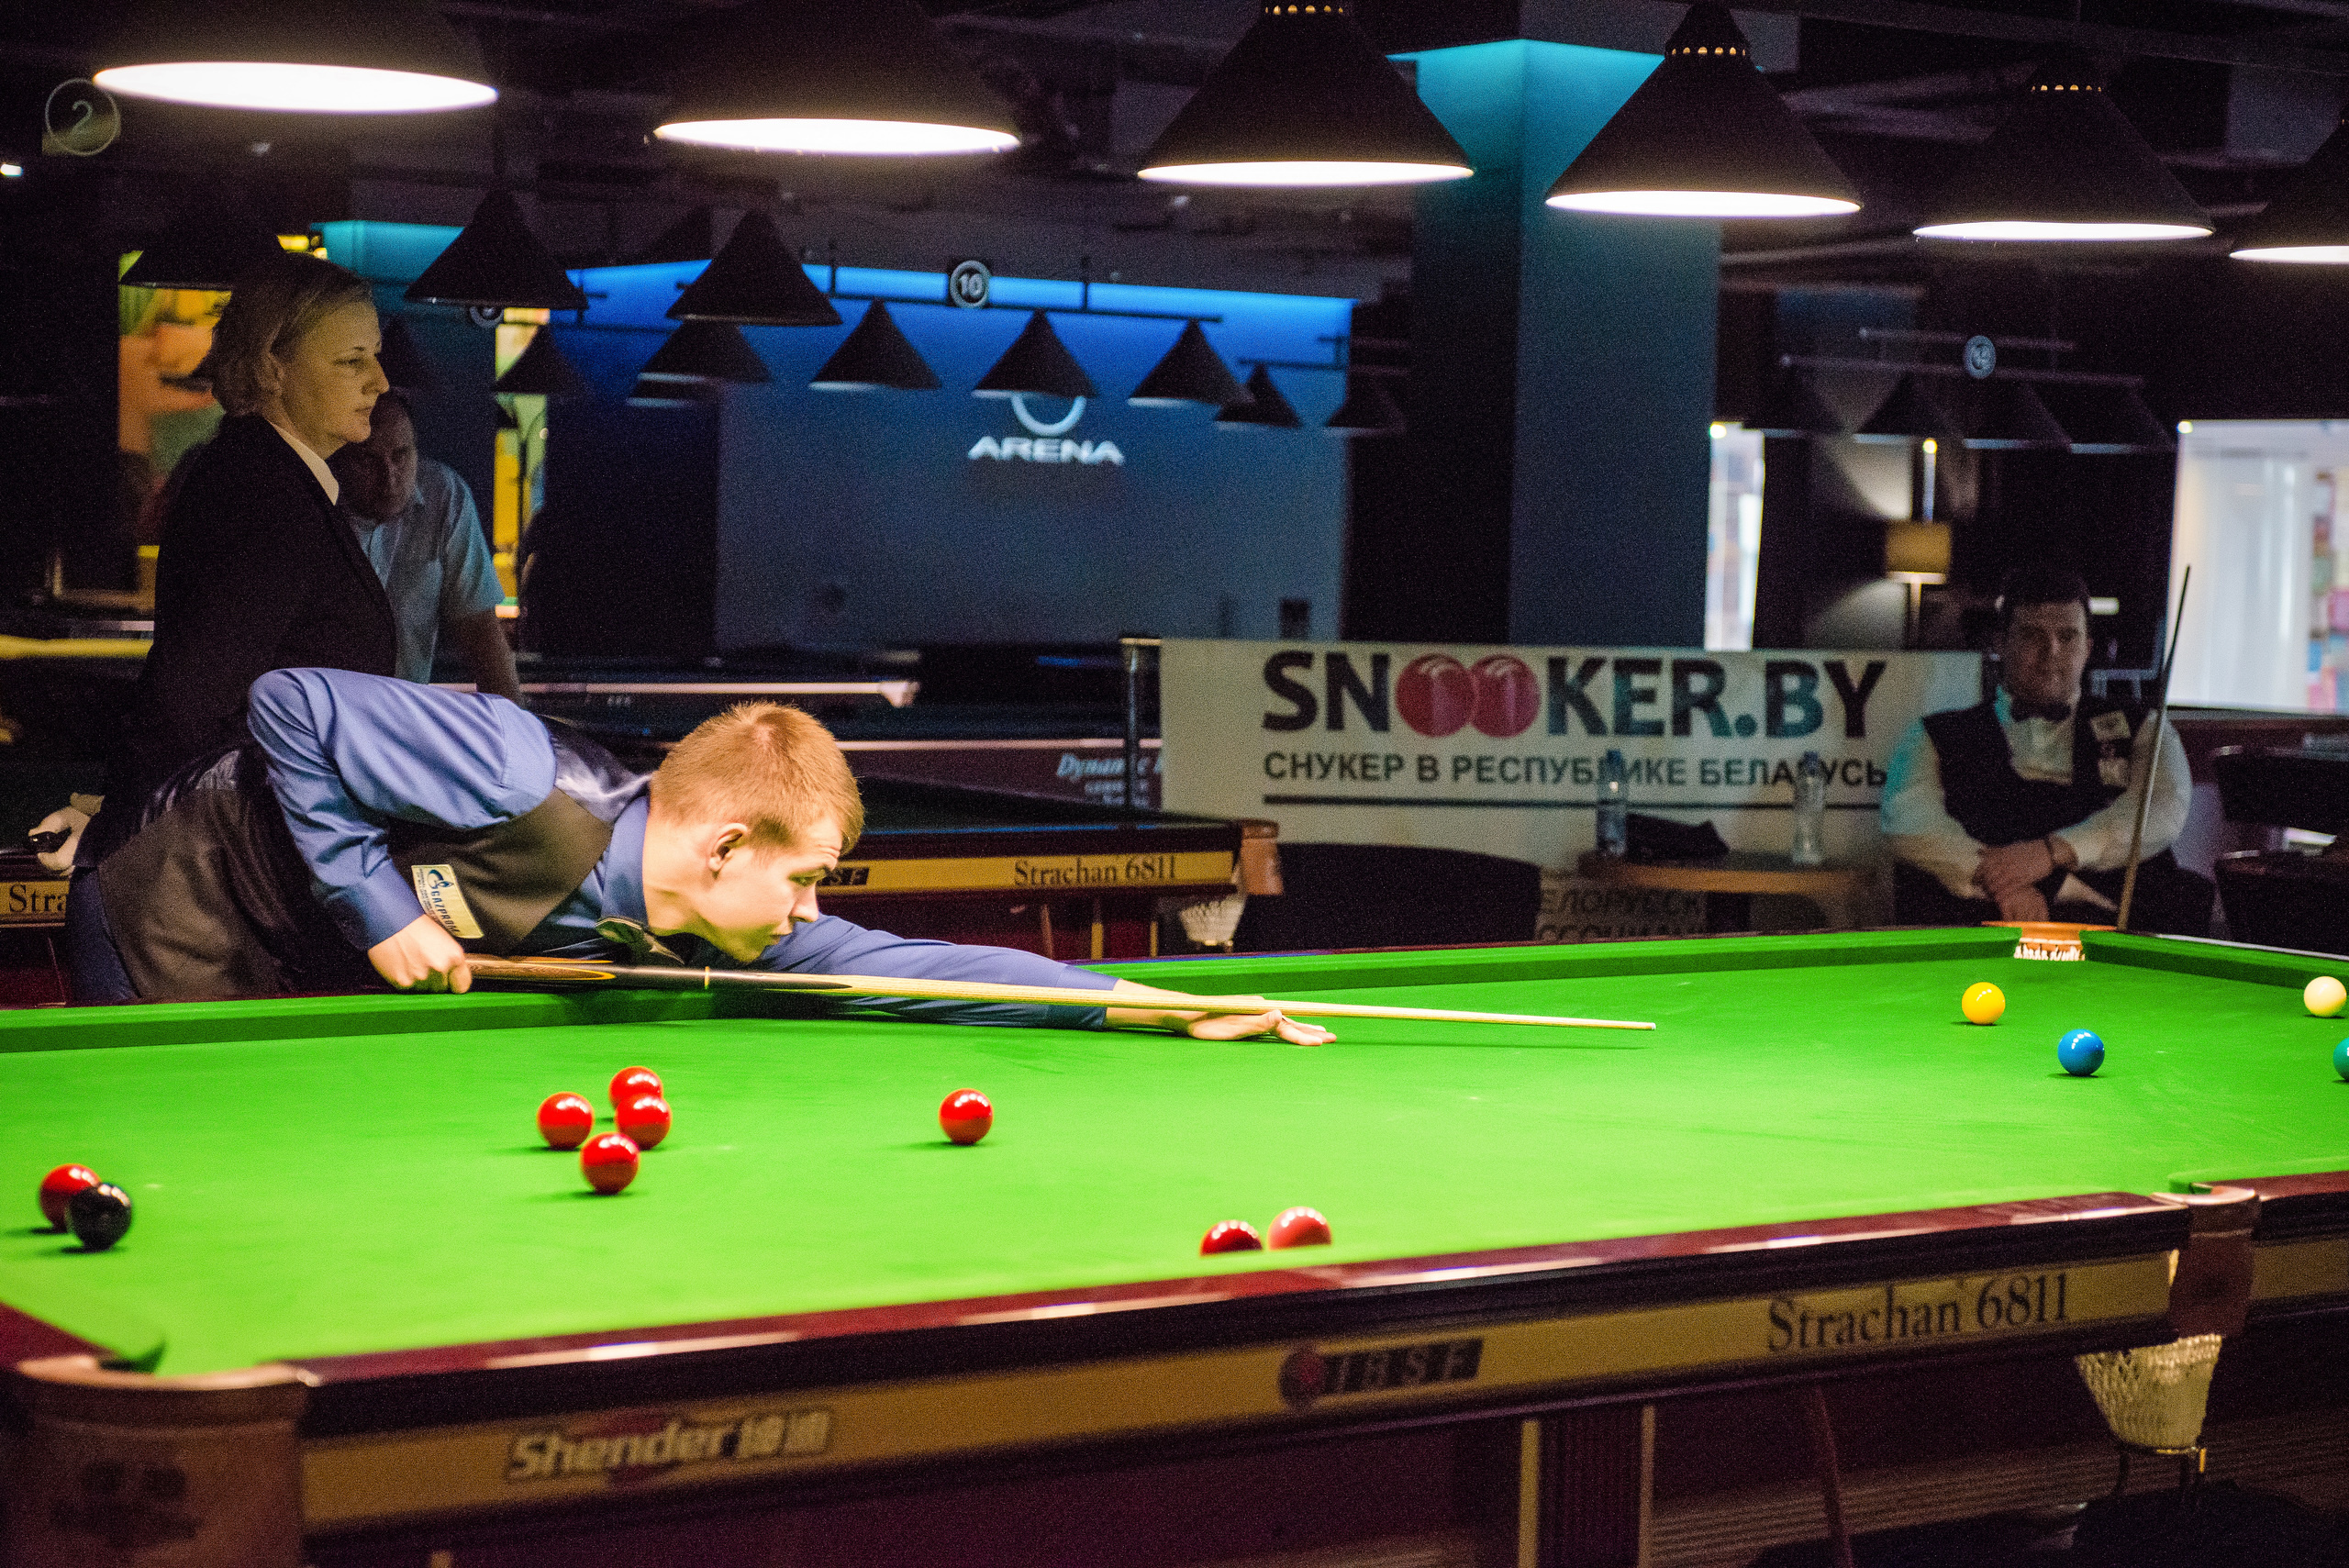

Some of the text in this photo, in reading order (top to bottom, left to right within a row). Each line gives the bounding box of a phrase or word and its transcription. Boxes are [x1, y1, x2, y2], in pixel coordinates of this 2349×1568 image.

[967, 435, 1126, 465] ARENA
[1262, 650, 1887, 738] SNOOKER.BY
[1264, 751, 1405, 781] СНУКЕР
[1417, 754, 1440, 781] В
[1699, 758, 1887, 786] БЕЛАУСЬ
[1014, 853, 1175, 886] Strachan 6811
[430, 890, 461, 934] GAZPROM
[1767, 1273, 2065, 1352] Strachan 6811
[507, 1420, 728, 1477] Shender
